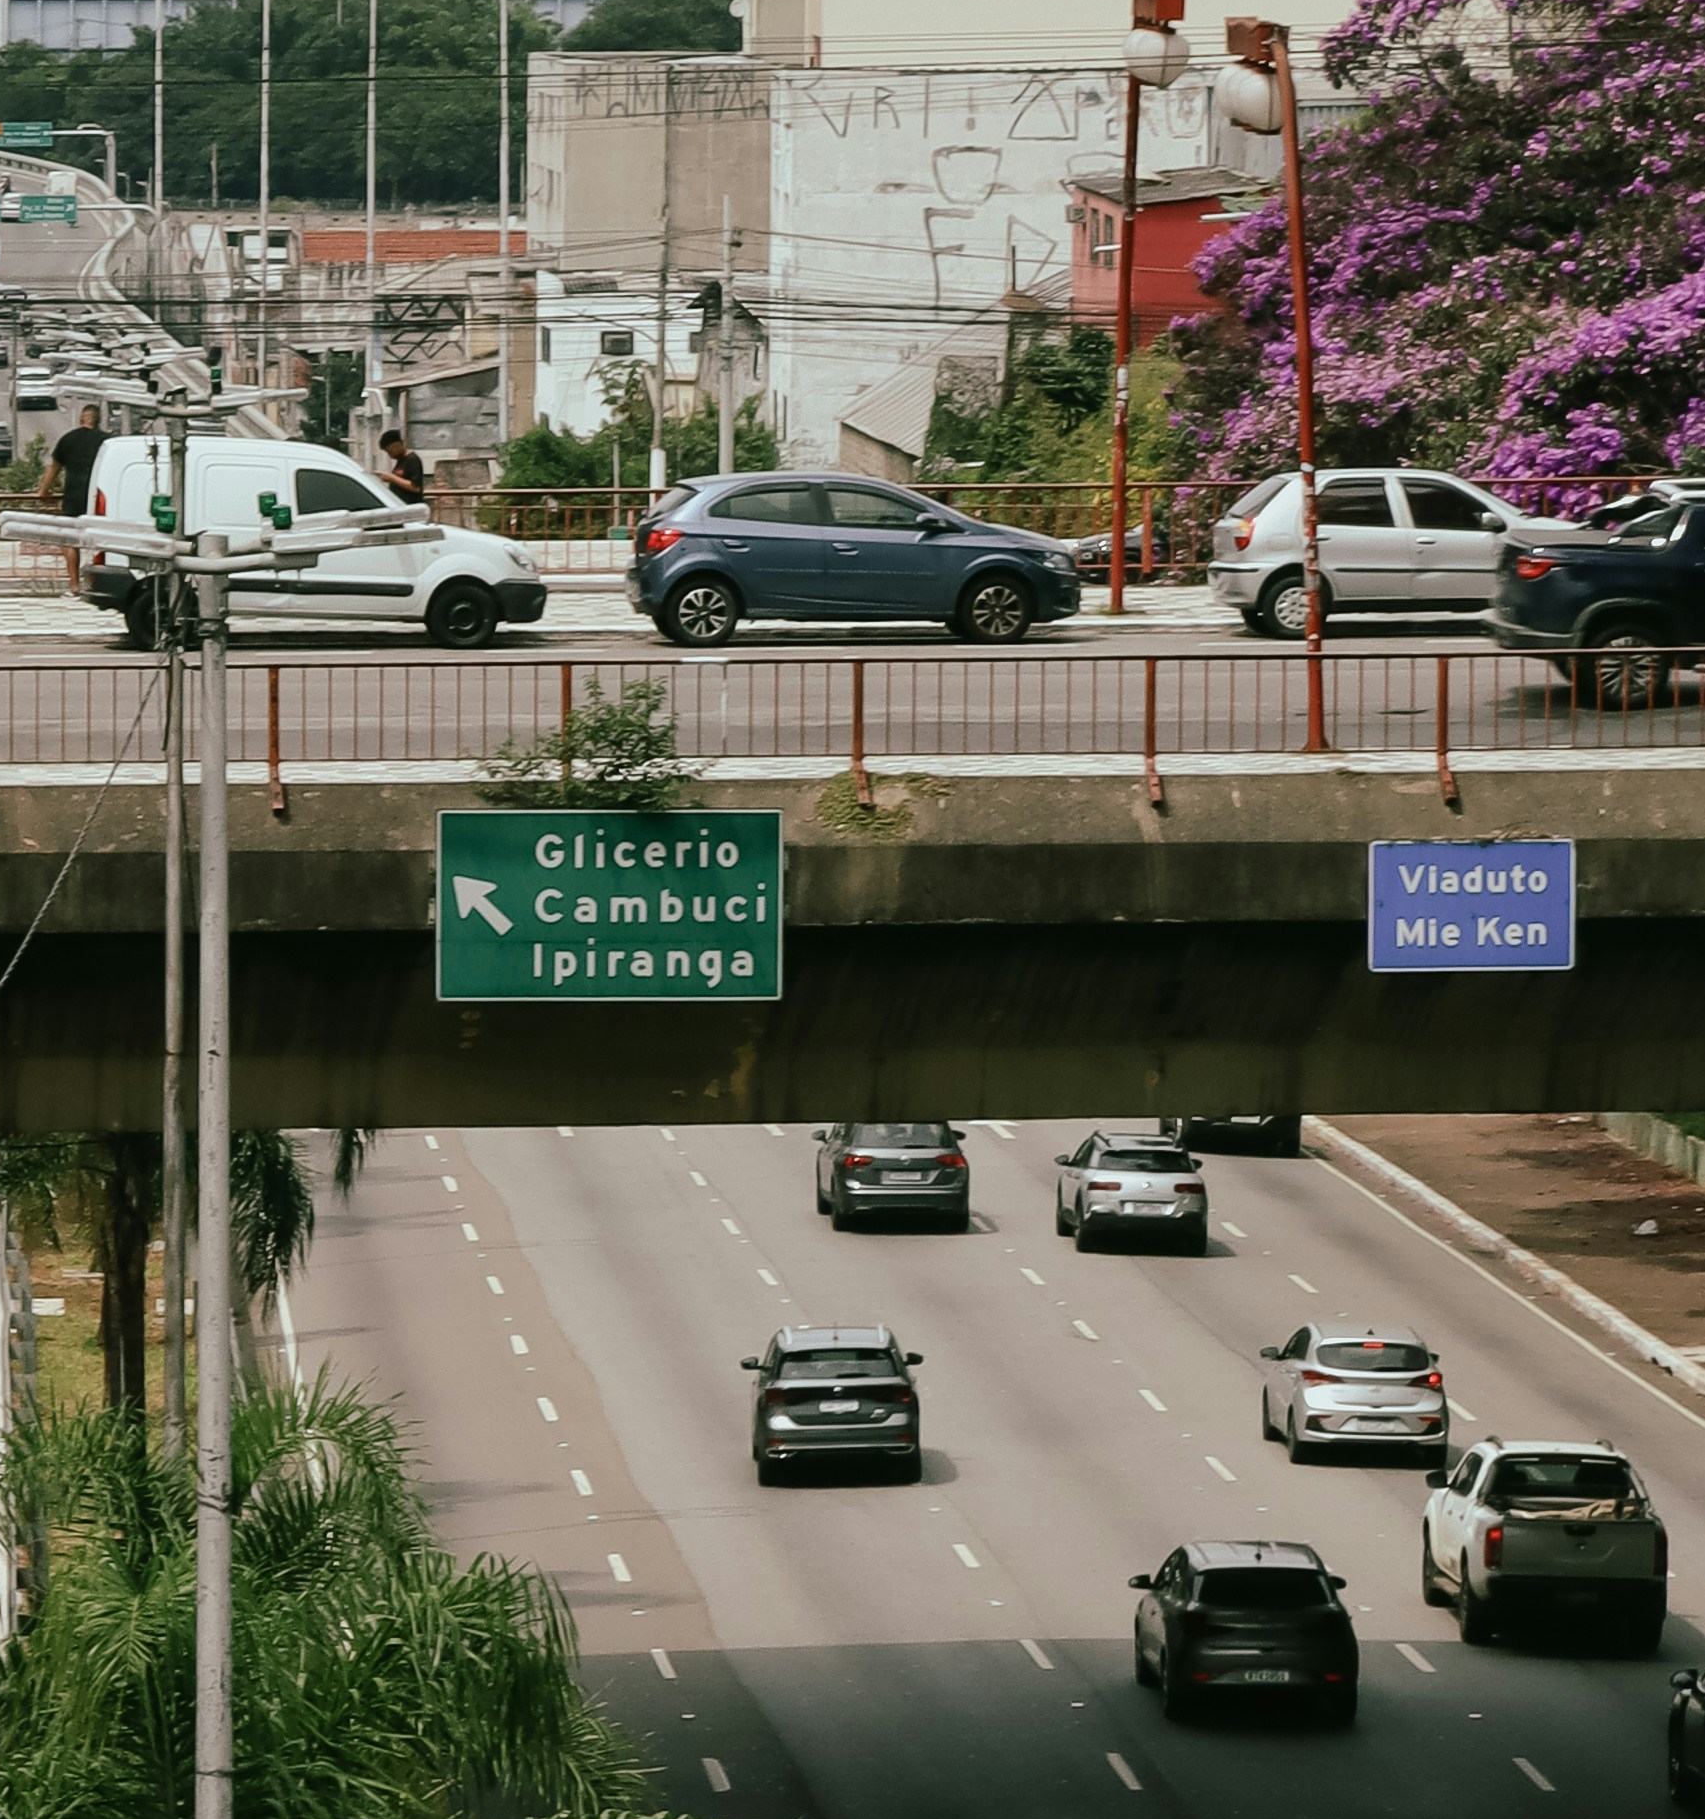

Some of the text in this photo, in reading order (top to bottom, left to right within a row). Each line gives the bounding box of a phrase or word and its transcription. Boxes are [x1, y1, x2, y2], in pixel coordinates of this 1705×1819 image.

[534, 828, 740, 869] Glicerio
[1398, 864, 1548, 894] Viaduto
[533, 882, 767, 924] Cambuci
[1396, 916, 1548, 948] Mie Ken
[532, 937, 755, 989] Ipiranga
